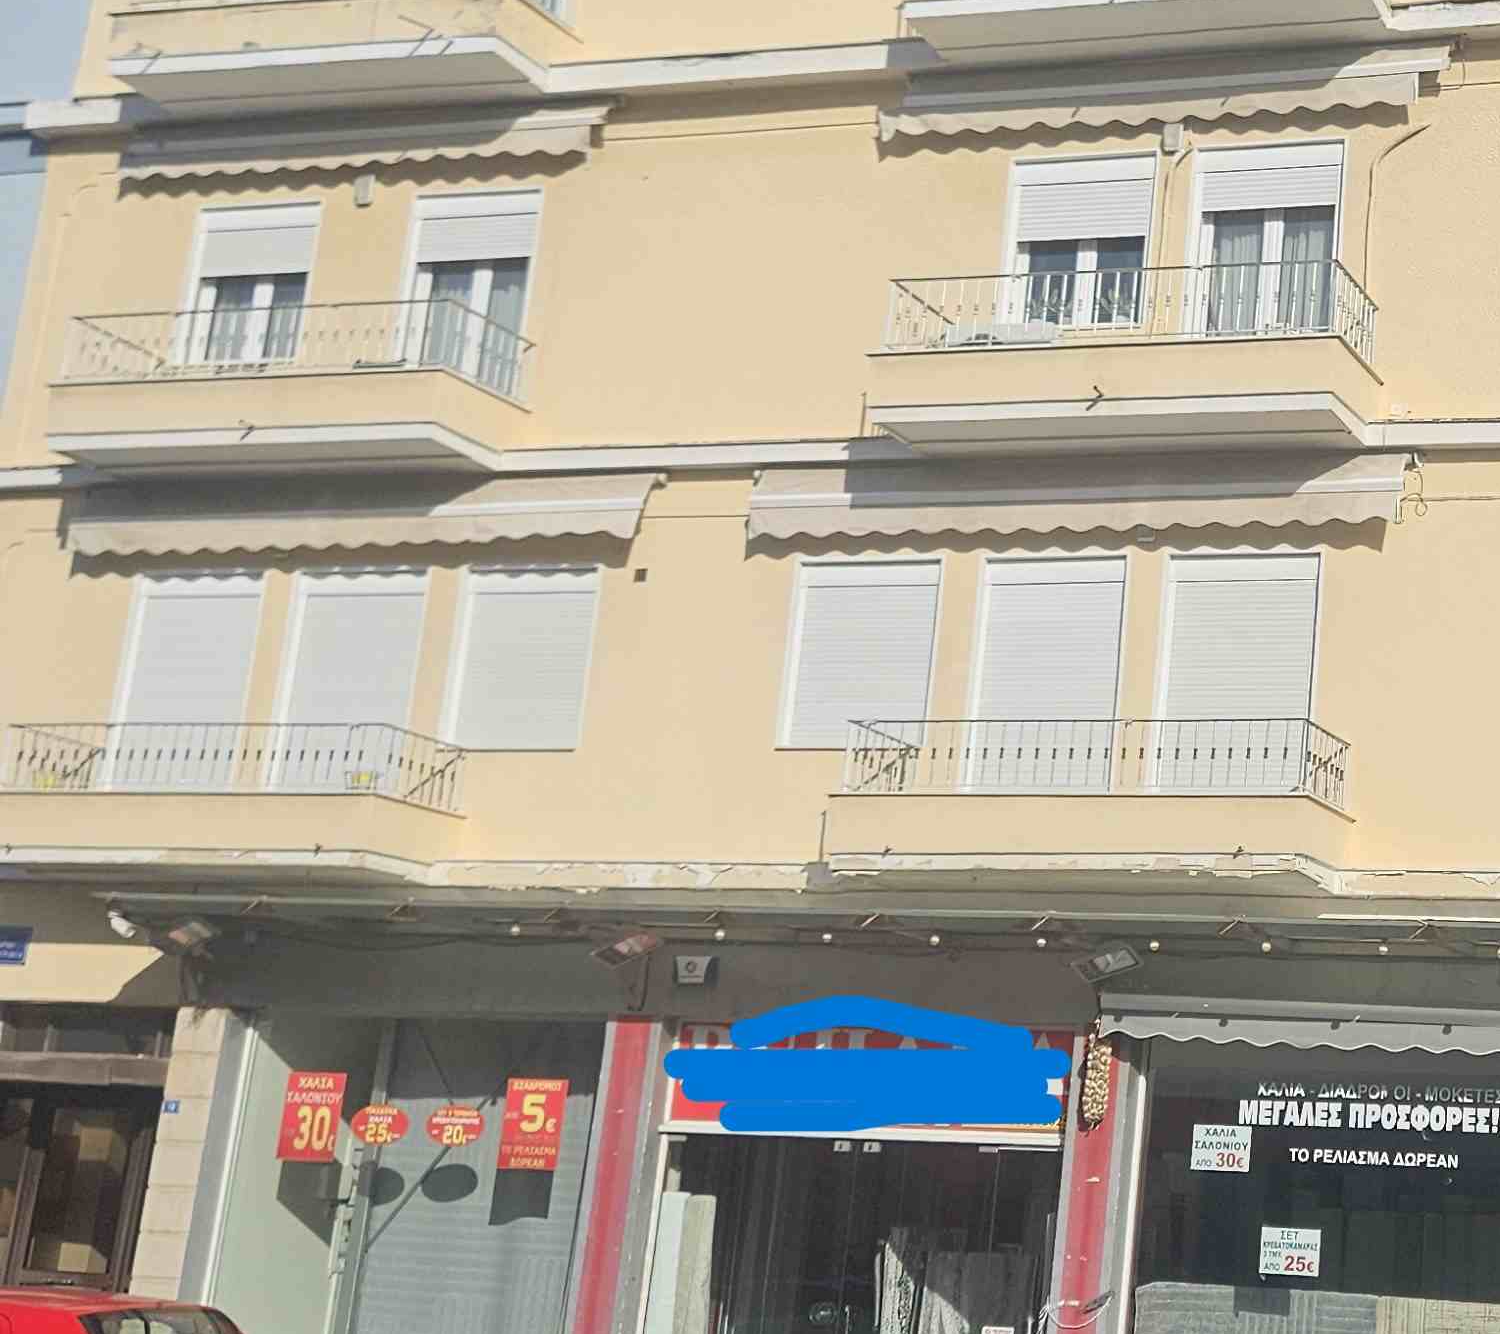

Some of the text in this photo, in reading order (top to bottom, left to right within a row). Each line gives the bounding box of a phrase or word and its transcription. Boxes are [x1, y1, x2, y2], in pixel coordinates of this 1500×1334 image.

[299, 1076, 335, 1089] ΧΑΛΙΑ
[1257, 1082, 1306, 1097] ΧΑΛΙΑ
[1238, 1099, 1343, 1128] ΜΕΓΑΛΕΣ
[1205, 1128, 1237, 1138] ΧΑΛΙΑ
[1194, 1140, 1249, 1152] ΣΑΛΟΝΙΟΥ
[1216, 1152, 1245, 1168] 30€
[1289, 1147, 1460, 1169] ΤΟ ΡΕΛΙΑΣΜΑ ΔΩΡΕΑΝ
[1284, 1255, 1315, 1273] 25€
